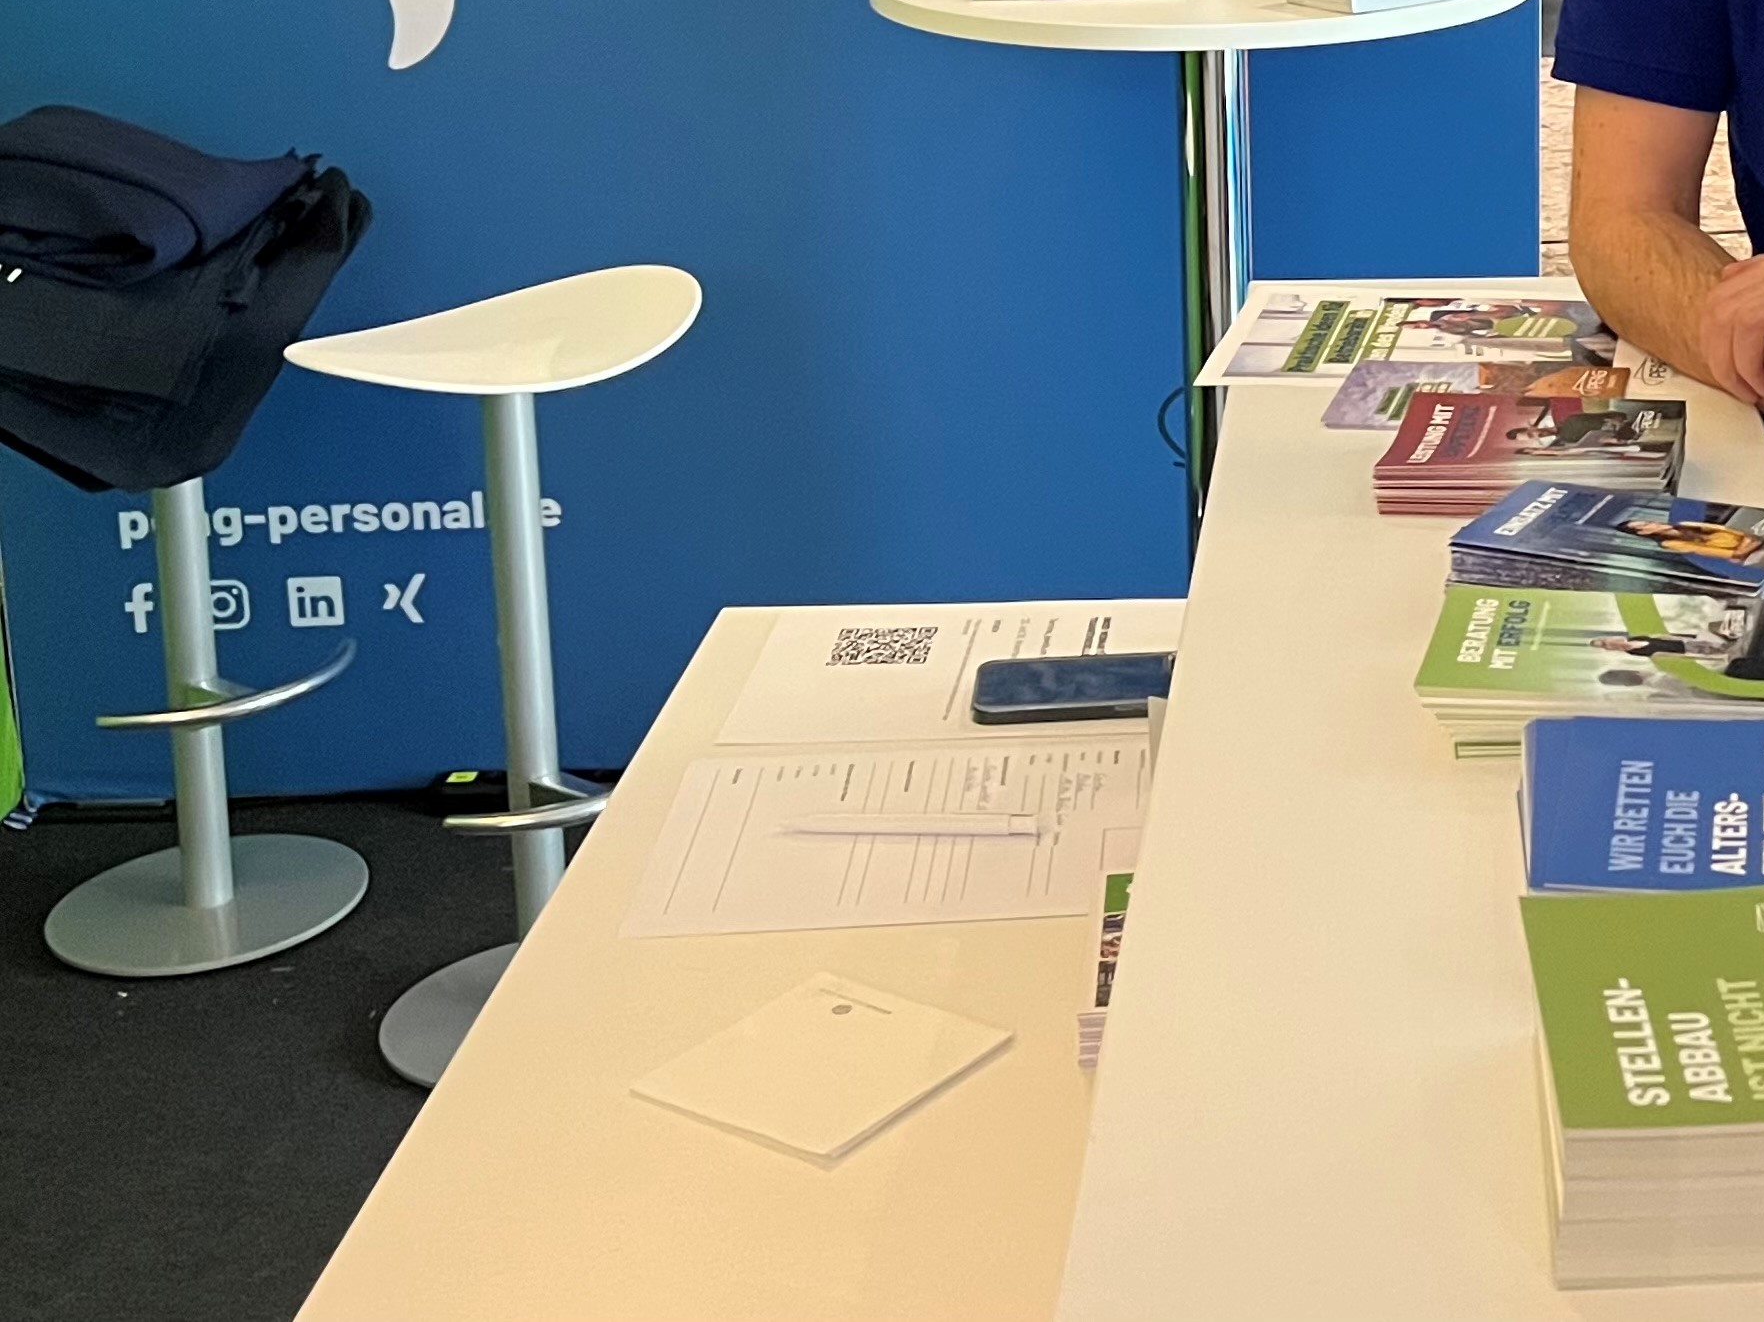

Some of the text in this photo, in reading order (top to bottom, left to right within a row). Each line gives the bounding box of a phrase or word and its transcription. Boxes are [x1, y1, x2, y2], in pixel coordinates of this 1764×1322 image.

[1430, 403, 1455, 424] MIT
[118, 491, 562, 549] pg-personale
[1457, 597, 1500, 663] BERATUNG
[1488, 599, 1532, 670] MIT ERFOLG
[1608, 760, 1654, 871] WIR RETTEN
[1659, 790, 1700, 875] EUCH DIE
[1710, 792, 1749, 876] ALTERS-
[1603, 977, 1671, 1106] STELLEN-
[1667, 1012, 1733, 1103] ABBAU
